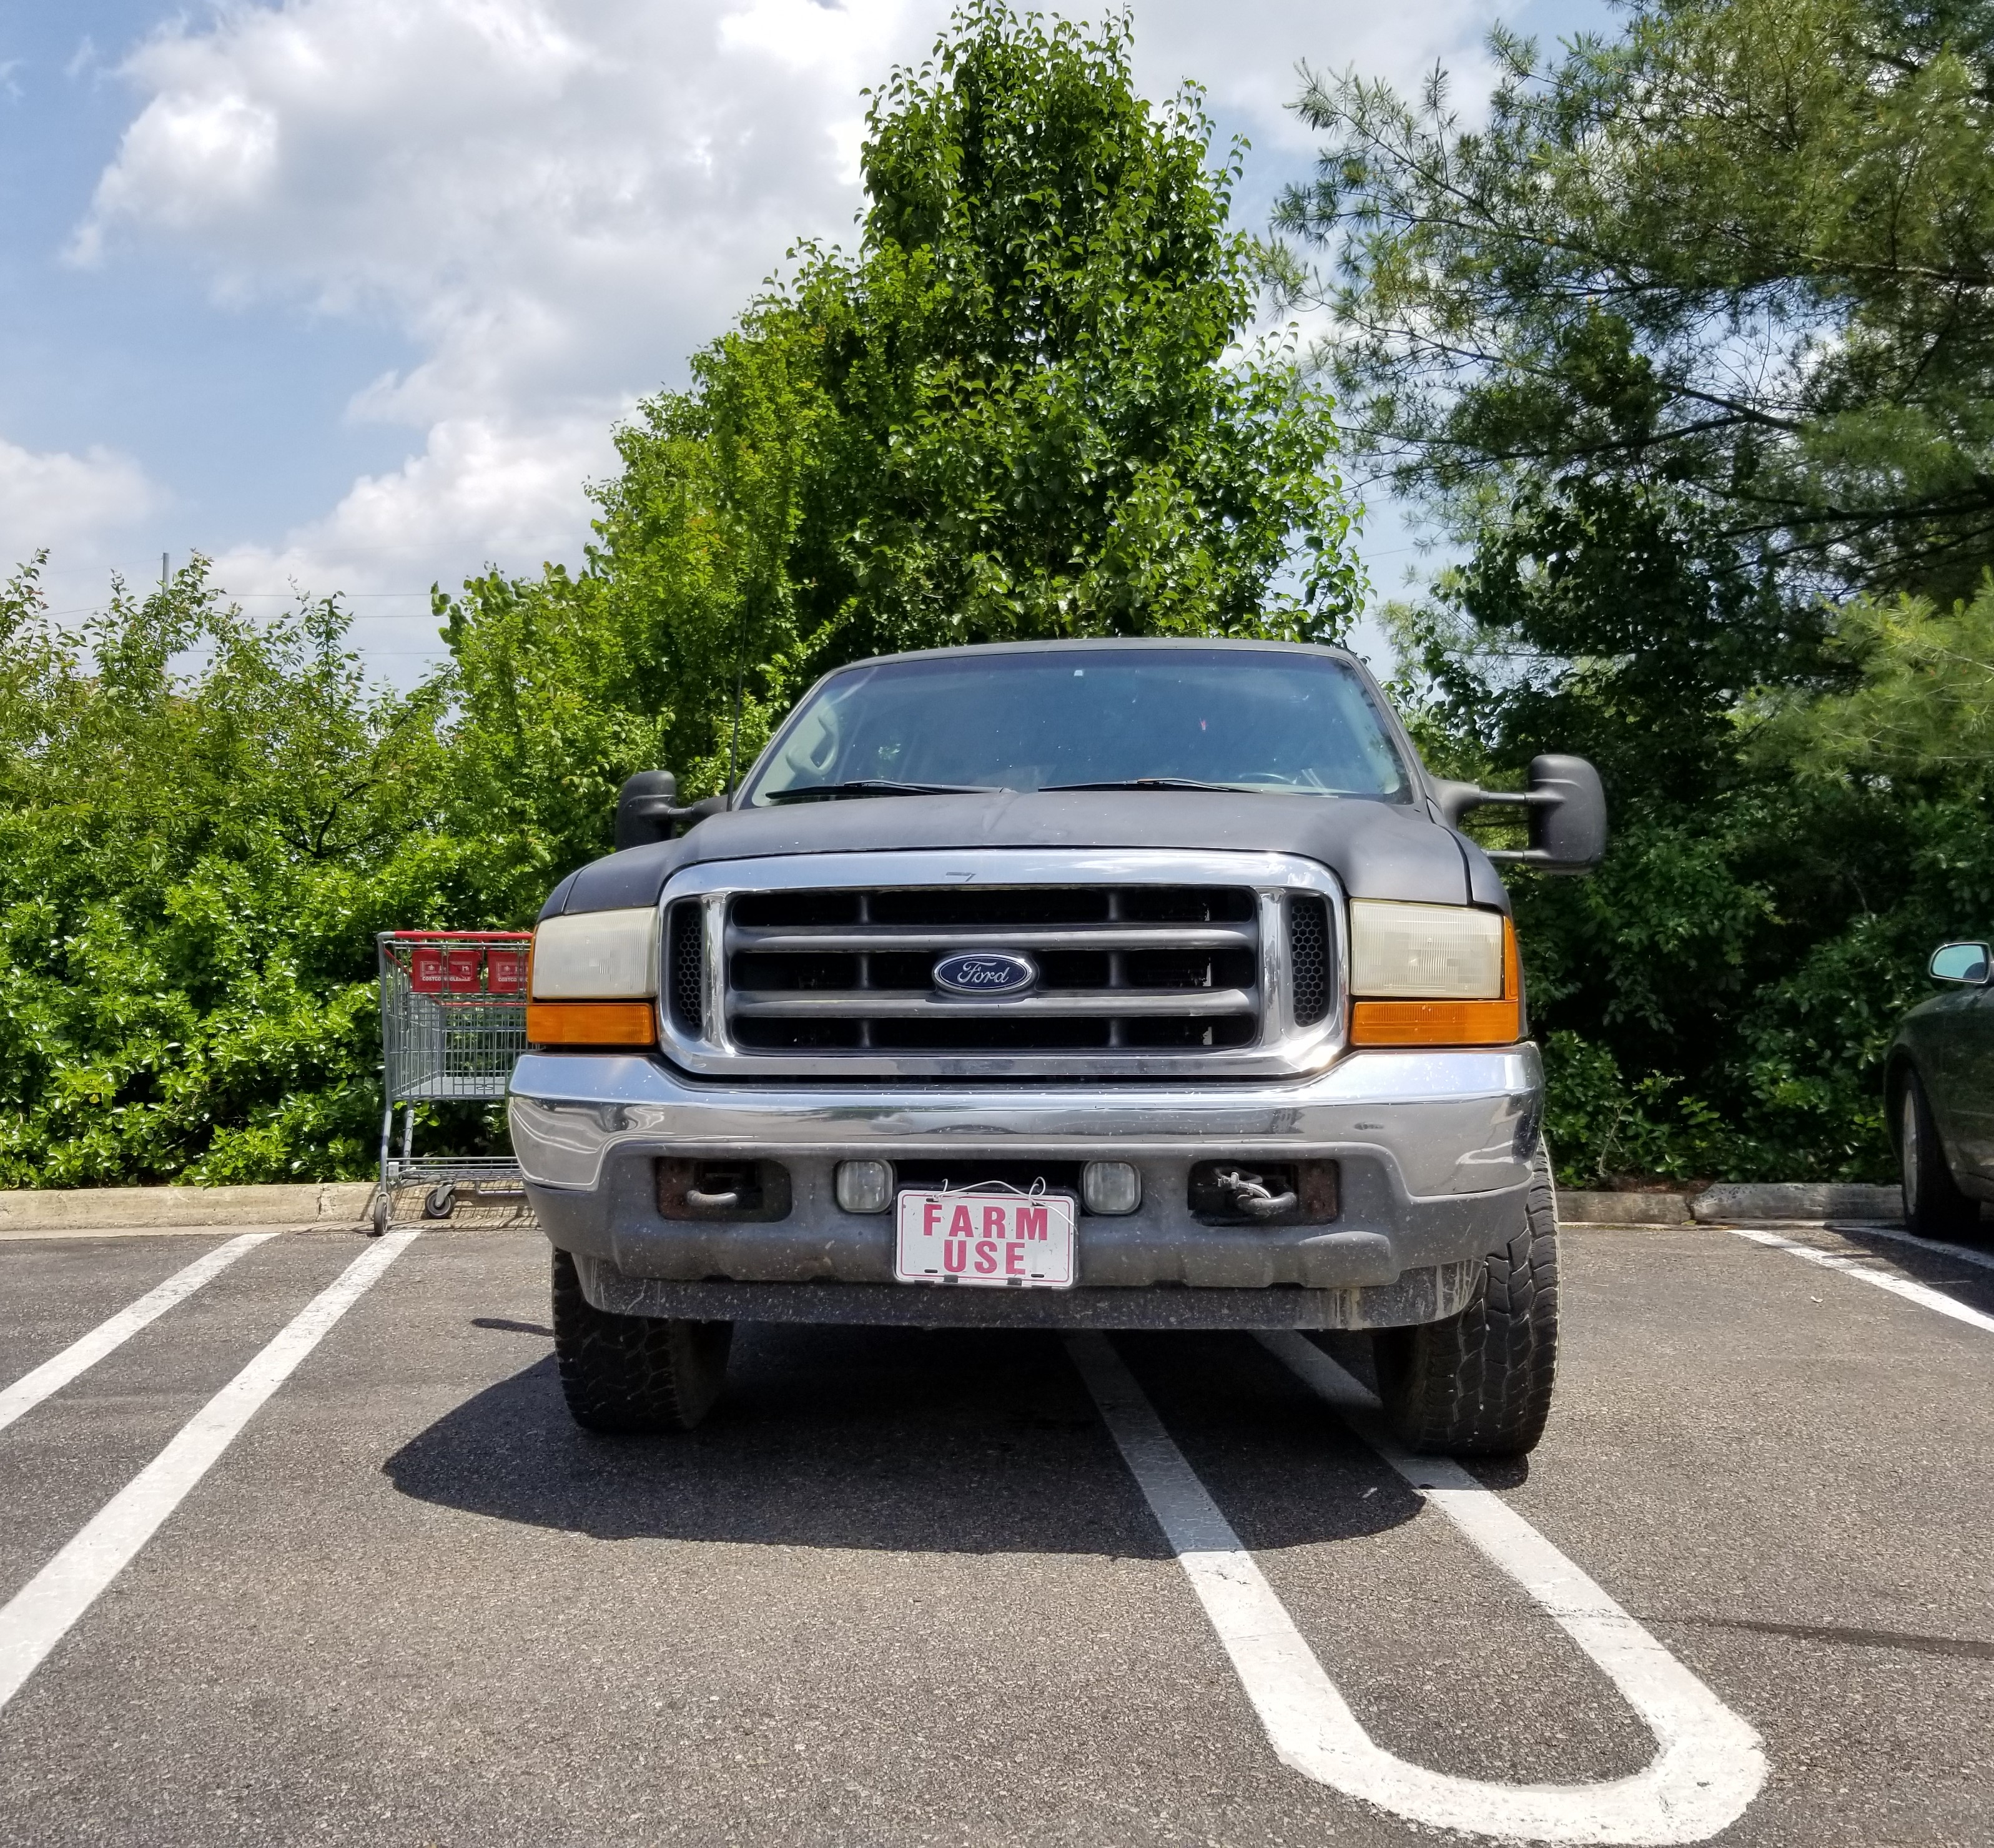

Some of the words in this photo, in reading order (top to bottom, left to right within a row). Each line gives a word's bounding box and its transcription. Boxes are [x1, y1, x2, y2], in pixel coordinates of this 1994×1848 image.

[957, 961, 1010, 983] Ford
[923, 1203, 1048, 1241] FARM
[944, 1239, 1026, 1275] USE
